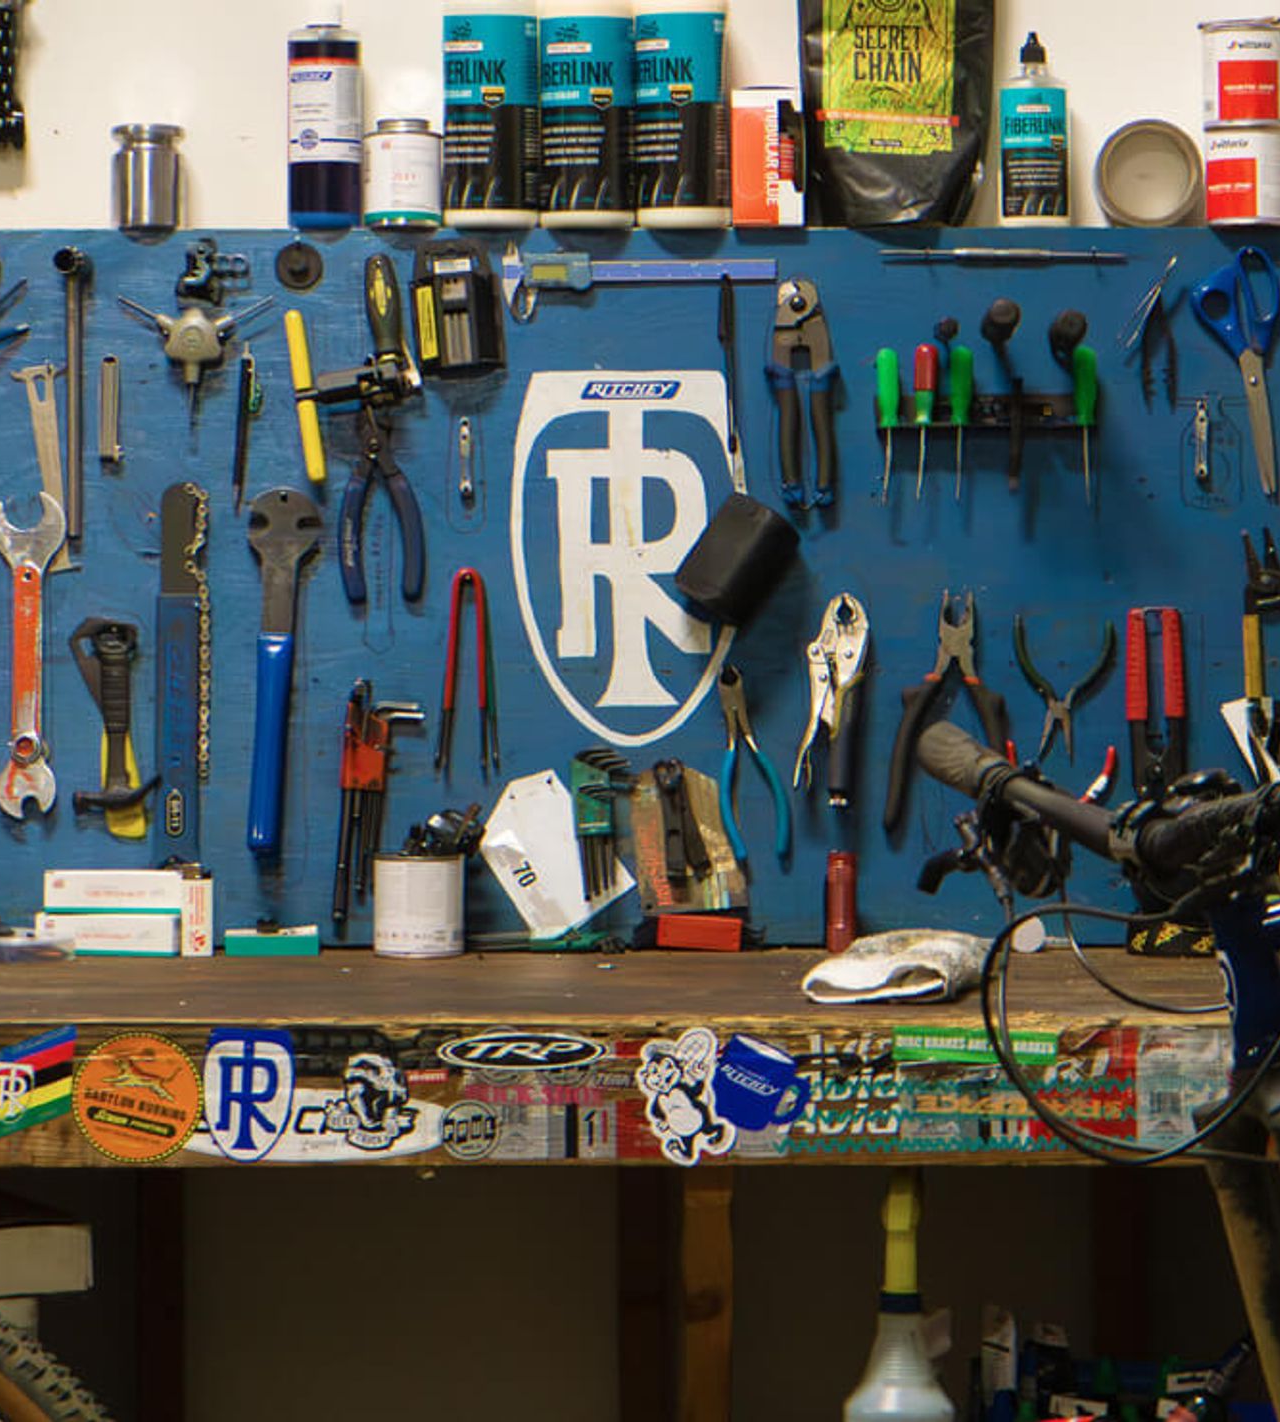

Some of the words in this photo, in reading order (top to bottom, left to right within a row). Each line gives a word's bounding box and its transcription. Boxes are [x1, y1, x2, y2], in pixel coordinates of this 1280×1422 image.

[854, 25, 921, 49] SECRET
[853, 51, 921, 82] CHAIN
[764, 107, 779, 168] TUBULAR
[764, 172, 779, 207] GLUE
[588, 382, 673, 398] RITCHEY
[512, 860, 537, 888] 70
[464, 1042, 584, 1062] TRP
